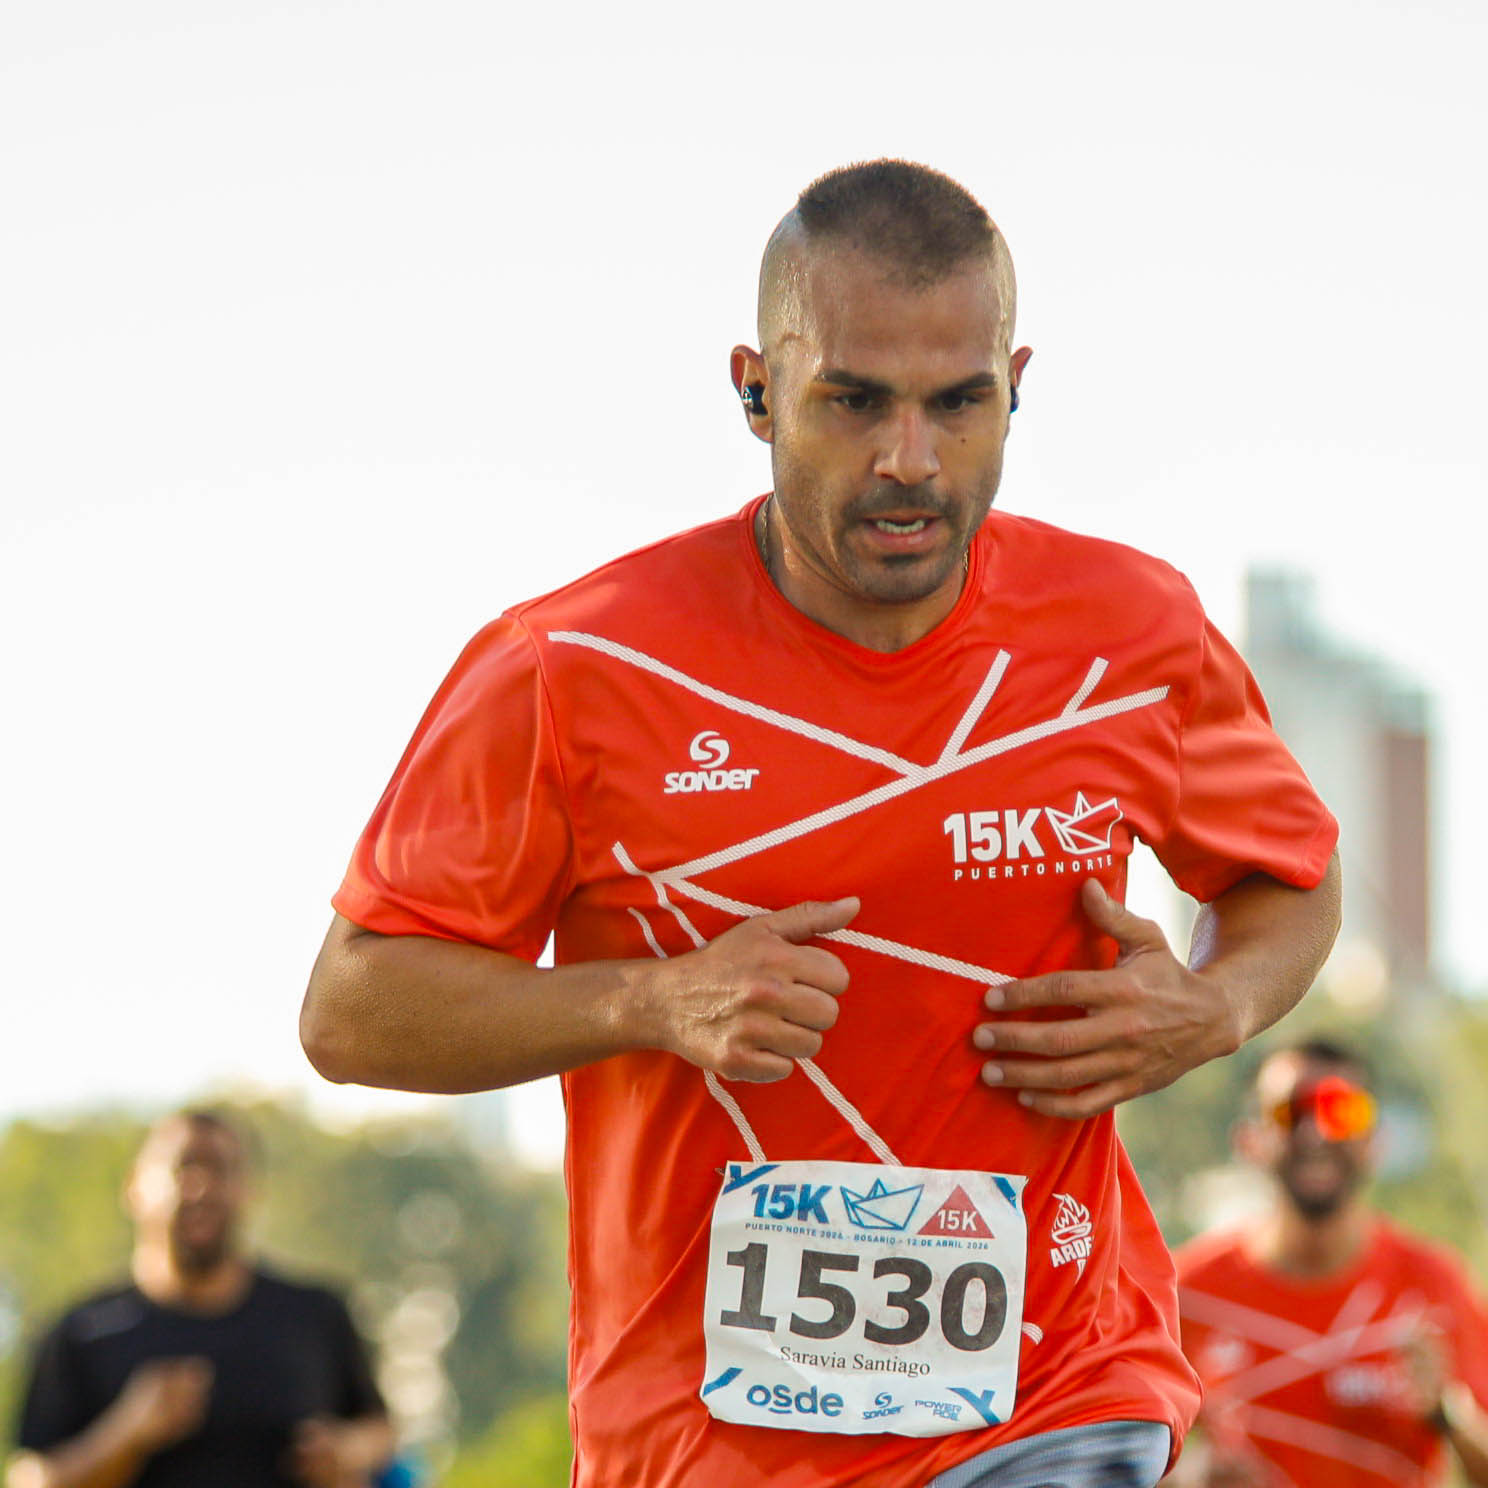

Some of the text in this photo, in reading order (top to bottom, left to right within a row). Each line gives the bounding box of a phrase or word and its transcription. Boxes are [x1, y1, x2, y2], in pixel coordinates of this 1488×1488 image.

[943, 808, 1045, 864] 15K
[954, 854, 1113, 881] PUERTO NORTE
[751, 1183, 833, 1225] 15K
[745, 1222, 783, 1233] PUERTO
[785, 1225, 817, 1237] NORTE
[854, 1233, 896, 1245] ROSARIO
[920, 1238, 933, 1247] DE
[936, 1239, 963, 1249] ABRIL
[937, 1209, 978, 1232] 15K
[719, 1242, 1008, 1352] 1530
[780, 1346, 931, 1378] Saravia Santiago
[746, 1384, 844, 1417] osde
[915, 1399, 962, 1413] POWER
